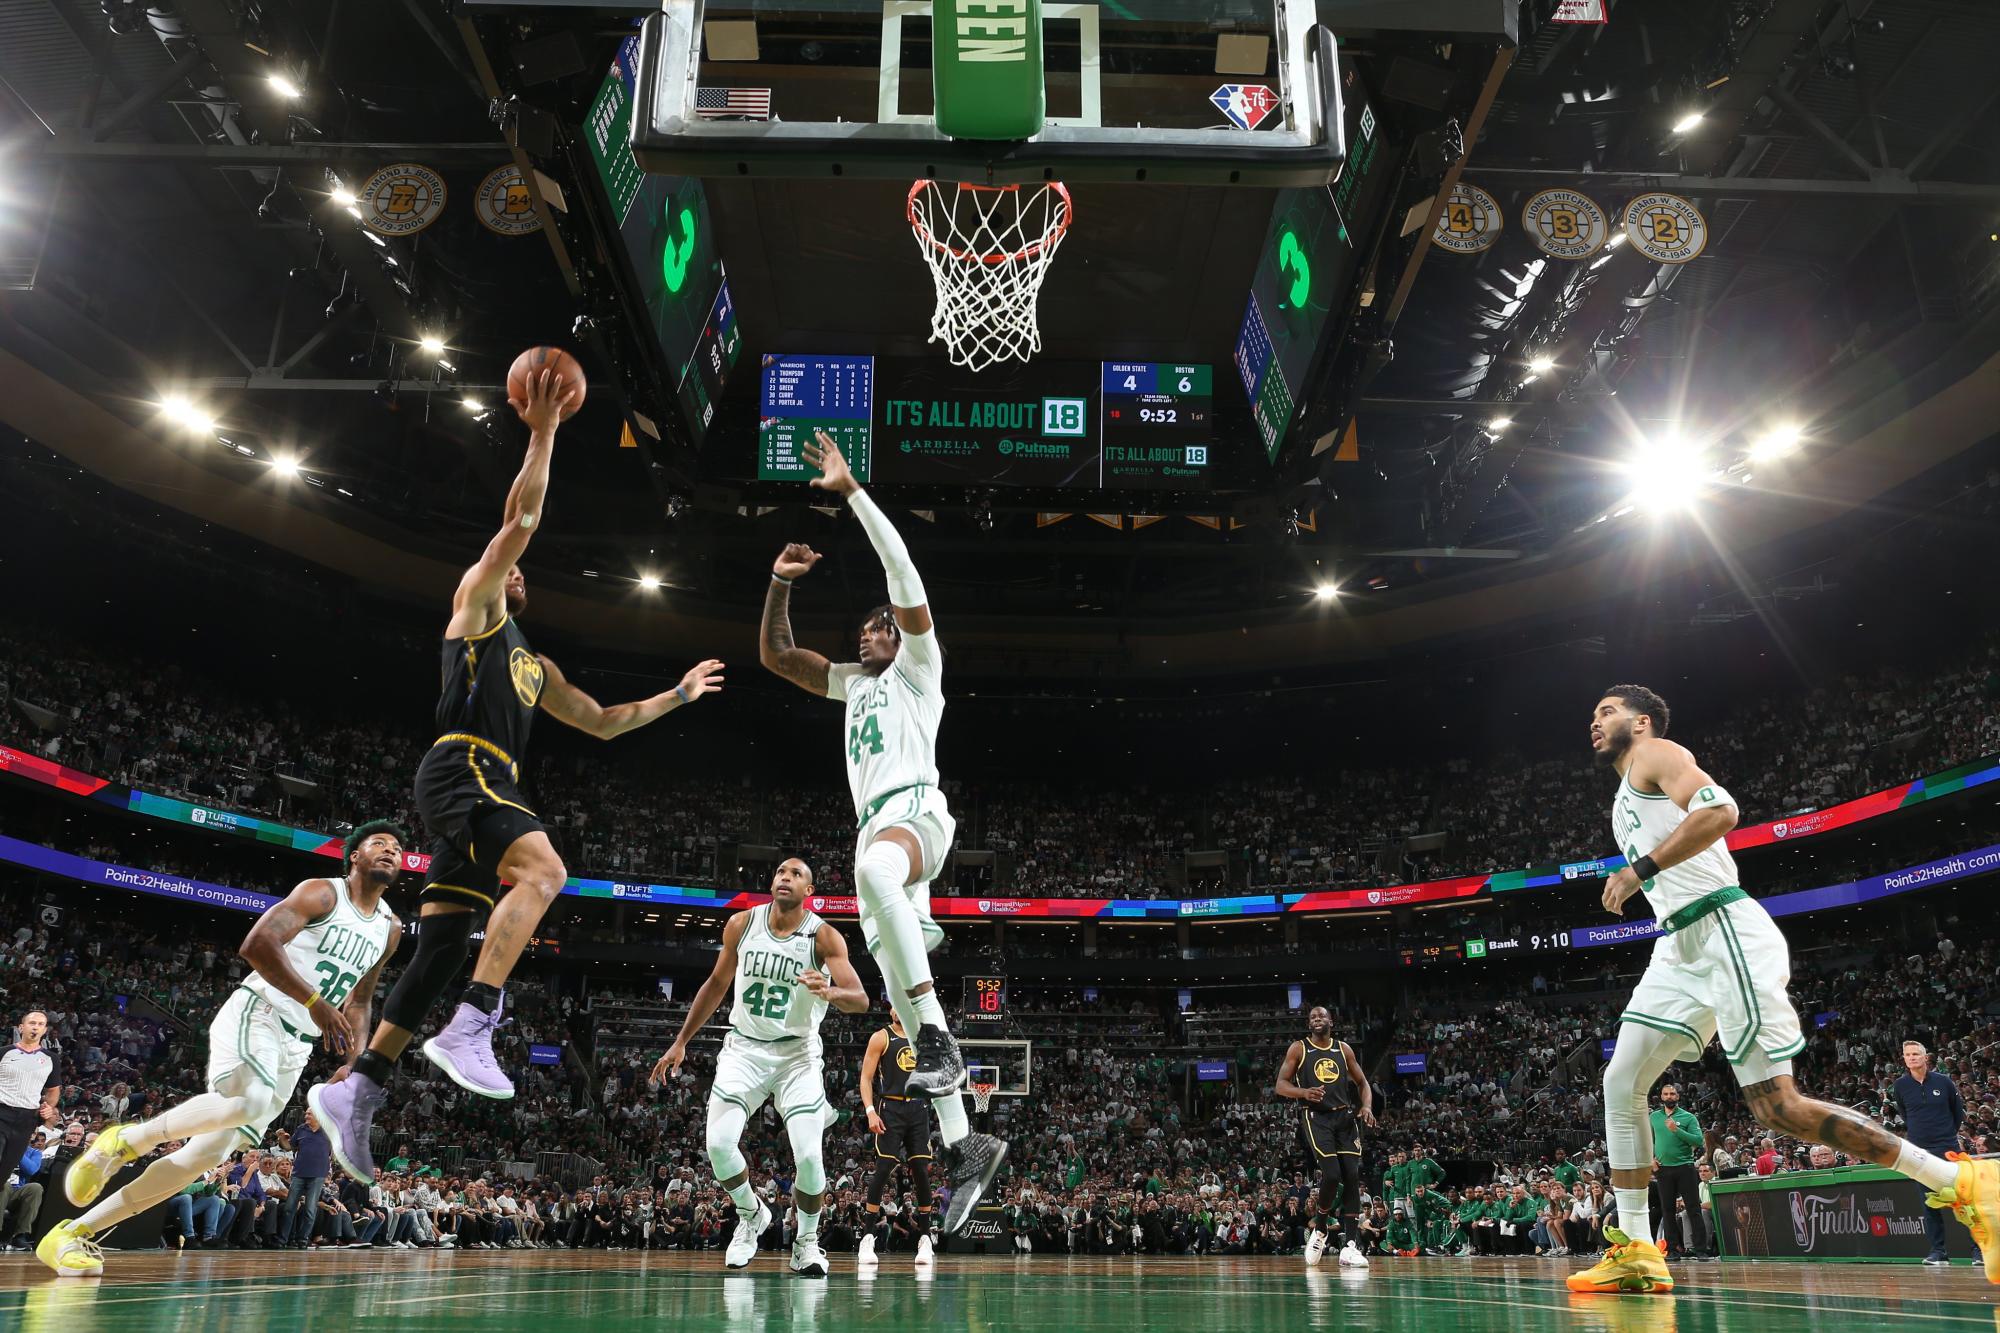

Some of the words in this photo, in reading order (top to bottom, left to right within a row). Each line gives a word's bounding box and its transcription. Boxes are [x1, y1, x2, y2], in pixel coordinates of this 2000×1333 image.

[1251, 92, 1265, 107] 75
[415, 169, 442, 207] BOURQUE
[480, 168, 512, 201] TERENCE
[393, 193, 415, 206] 77
[509, 195, 528, 205] 24
[1476, 194, 1494, 212] ORR
[1528, 196, 1553, 220] LIONEL
[1554, 193, 1601, 223] HITCHMAN
[1629, 198, 1656, 225] EDWARD
[1674, 202, 1701, 230] SHORE
[371, 216, 424, 231] 1979-2000
[1452, 208, 1469, 227] 4
[1556, 215, 1573, 234] 3
[1656, 219, 1673, 237] 2
[1543, 241, 1592, 255] 1925-1934
[1644, 244, 1691, 259] 1926-1940
[1112, 364, 1131, 372] GOLDEN
[1132, 365, 1146, 373] STATE
[1175, 366, 1195, 374] BOSTON
[1123, 375, 1137, 391] 4
[1178, 376, 1192, 393] 6
[886, 400, 923, 426] IT'S
[929, 401, 965, 428] ALL
[969, 402, 1038, 429] ABOUT
[1048, 404, 1080, 429] 18
[1140, 409, 1177, 423] 9:52
[1191, 412, 1203, 420] 1st
[912, 440, 980, 449] ARBELLA
[1015, 442, 1070, 454] Putnam
[1105, 446, 1125, 461] IT'S
[1127, 448, 1146, 461] ALL
[1148, 448, 1183, 462] ABOUT
[1188, 449, 1205, 462] 18
[524, 656, 540, 680] 30
[849, 713, 884, 766] 44
[1701, 788, 1716, 802] 0
[207, 811, 238, 825] TUFTS
[1577, 861, 1606, 873] TUFTS
[1884, 859, 1966, 890] Point32Health
[105, 868, 194, 896] Point32Health
[197, 888, 266, 909] companies
[626, 885, 653, 894] TUFTS
[1193, 900, 1219, 908] TUFTS
[1468, 943, 1484, 955] TD
[1488, 938, 1519, 950] Bank
[1531, 932, 1569, 950] 9:10
[743, 951, 804, 987] CELTICS
[315, 960, 358, 1006] 36
[976, 979, 1001, 991] 9:52
[742, 981, 790, 1020] 42
[980, 991, 999, 1011] 18
[1322, 1061, 1334, 1069] 23
[1866, 1198, 1887, 1213] Presented
[964, 1219, 1003, 1239] Finals
[1803, 1193, 1869, 1253] Finals
